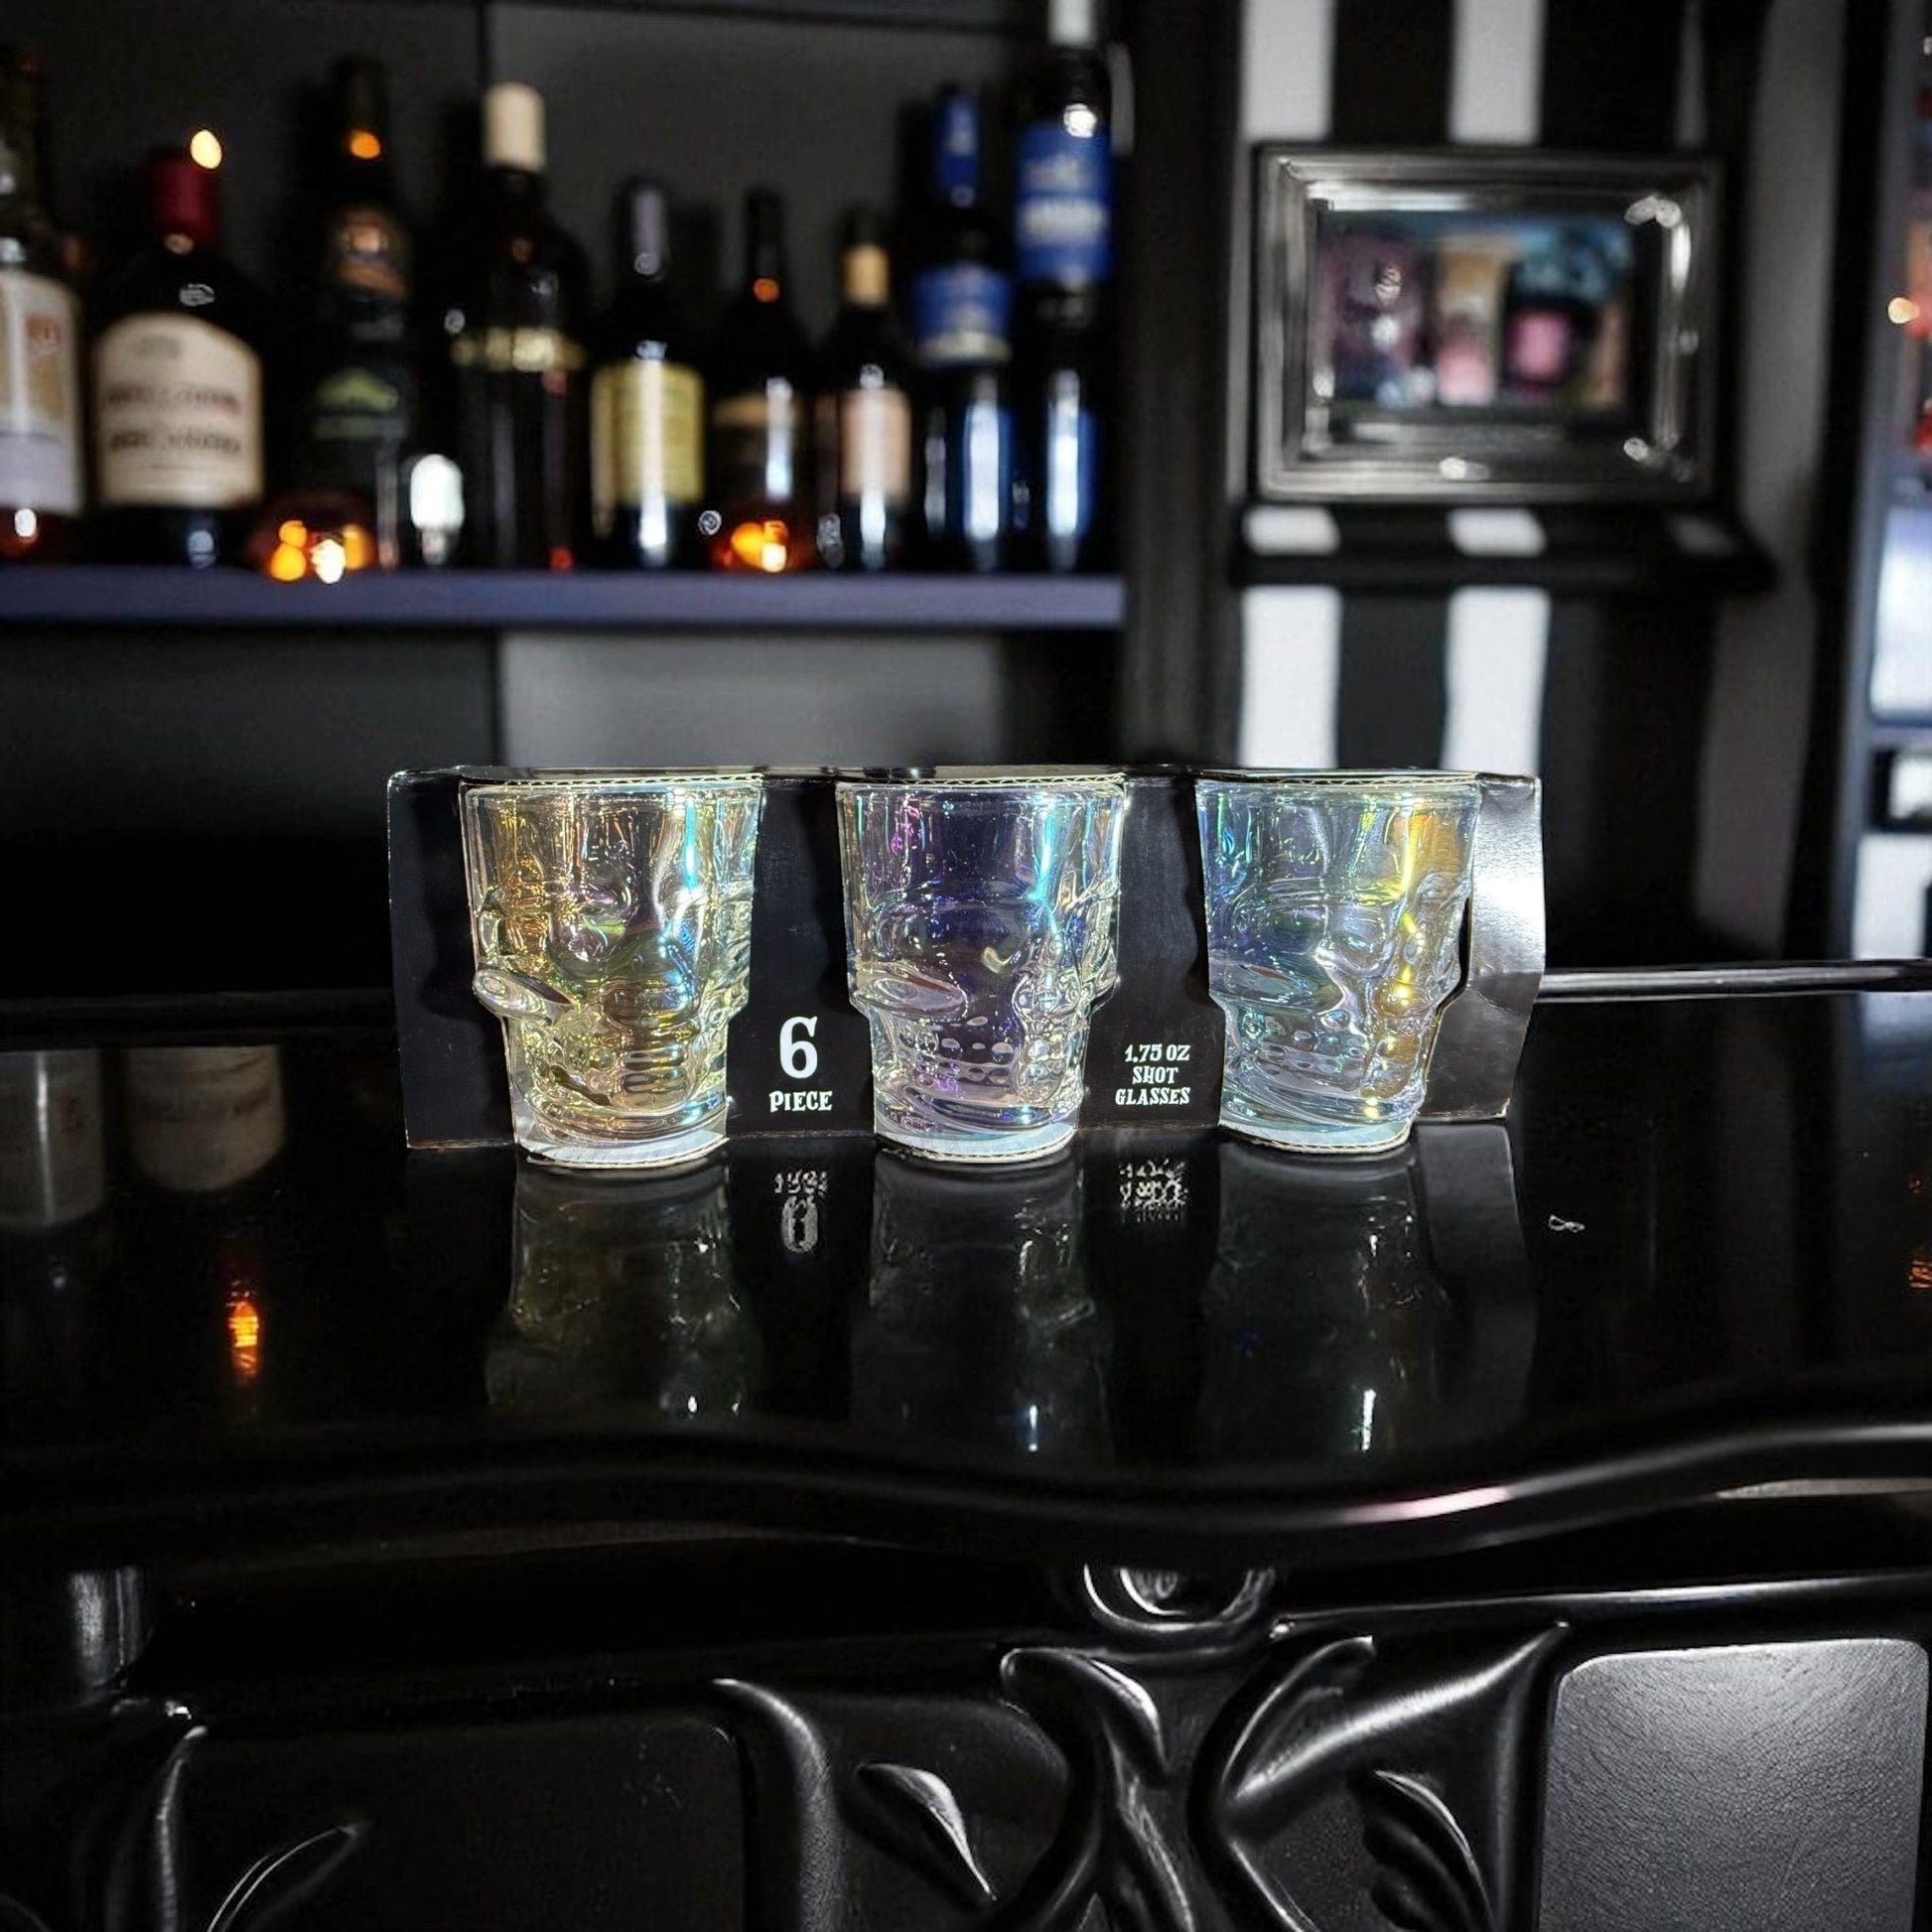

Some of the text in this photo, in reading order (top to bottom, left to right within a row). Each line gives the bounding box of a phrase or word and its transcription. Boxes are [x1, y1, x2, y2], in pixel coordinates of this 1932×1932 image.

[779, 1016, 818, 1079] 6
[1124, 1043, 1191, 1063] 1.75 OZ
[1131, 1065, 1179, 1085] SHOT
[768, 1090, 833, 1113] PIECE
[1114, 1086, 1191, 1106] GLASSES
